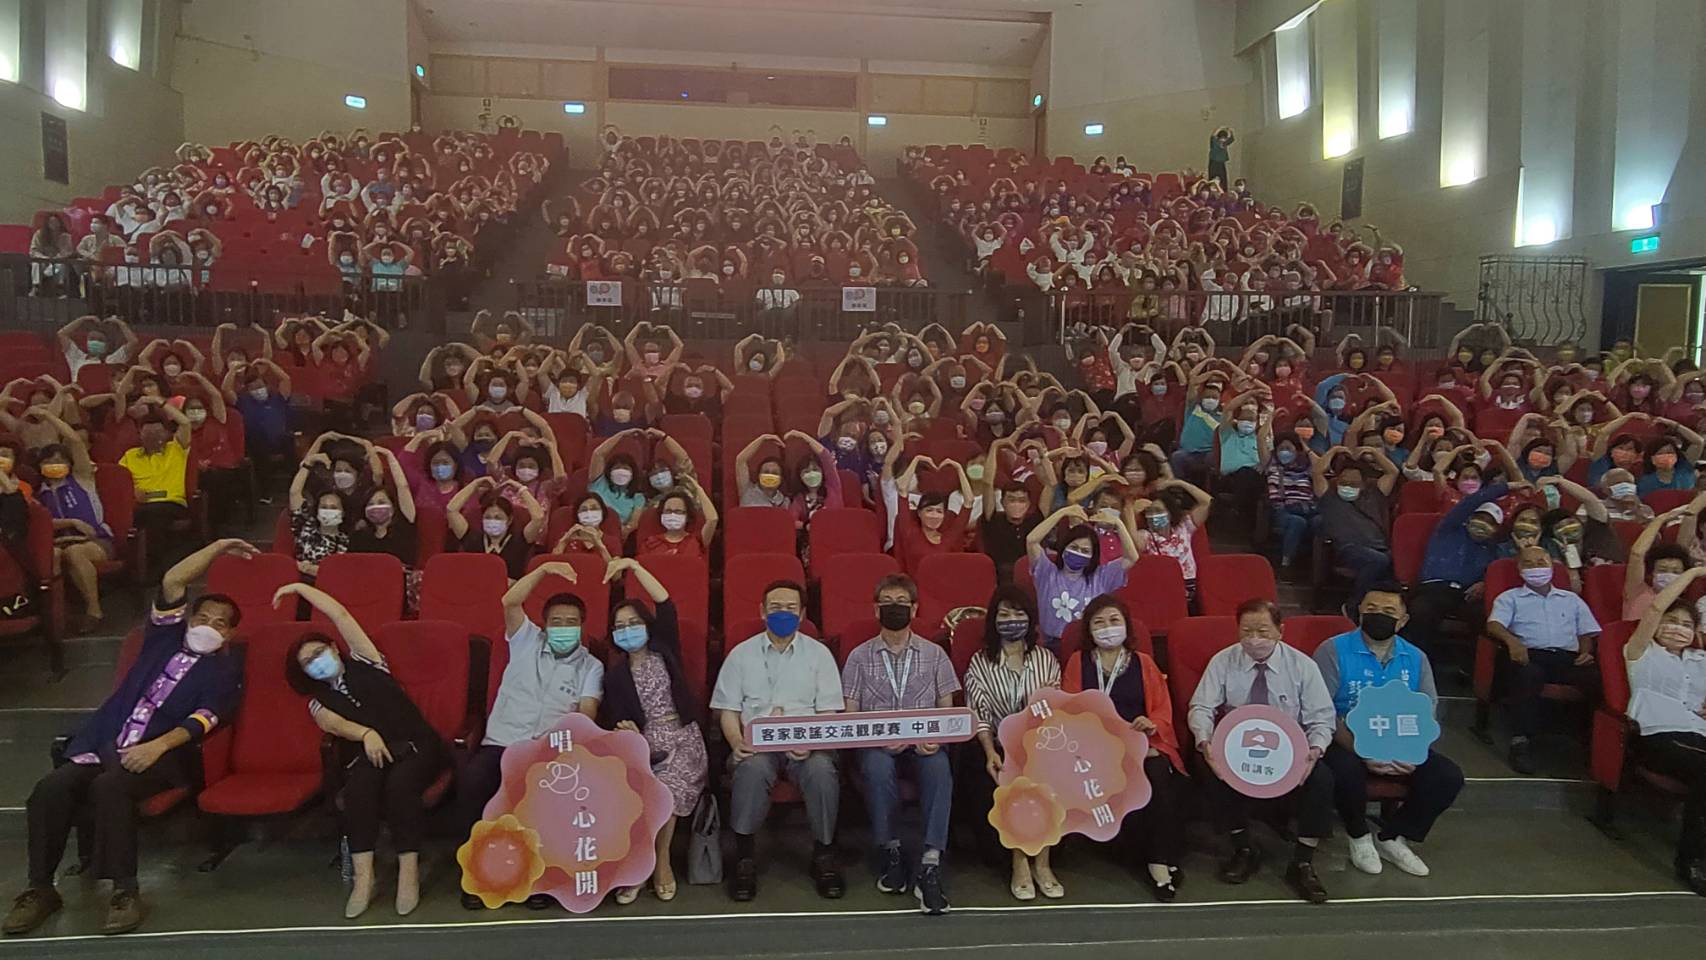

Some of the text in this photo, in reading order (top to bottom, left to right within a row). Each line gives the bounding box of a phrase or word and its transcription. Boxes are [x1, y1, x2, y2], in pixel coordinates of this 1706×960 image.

[911, 720, 941, 733] 中區
[1368, 714, 1420, 737] 中區
[572, 805, 598, 896] 心花開
